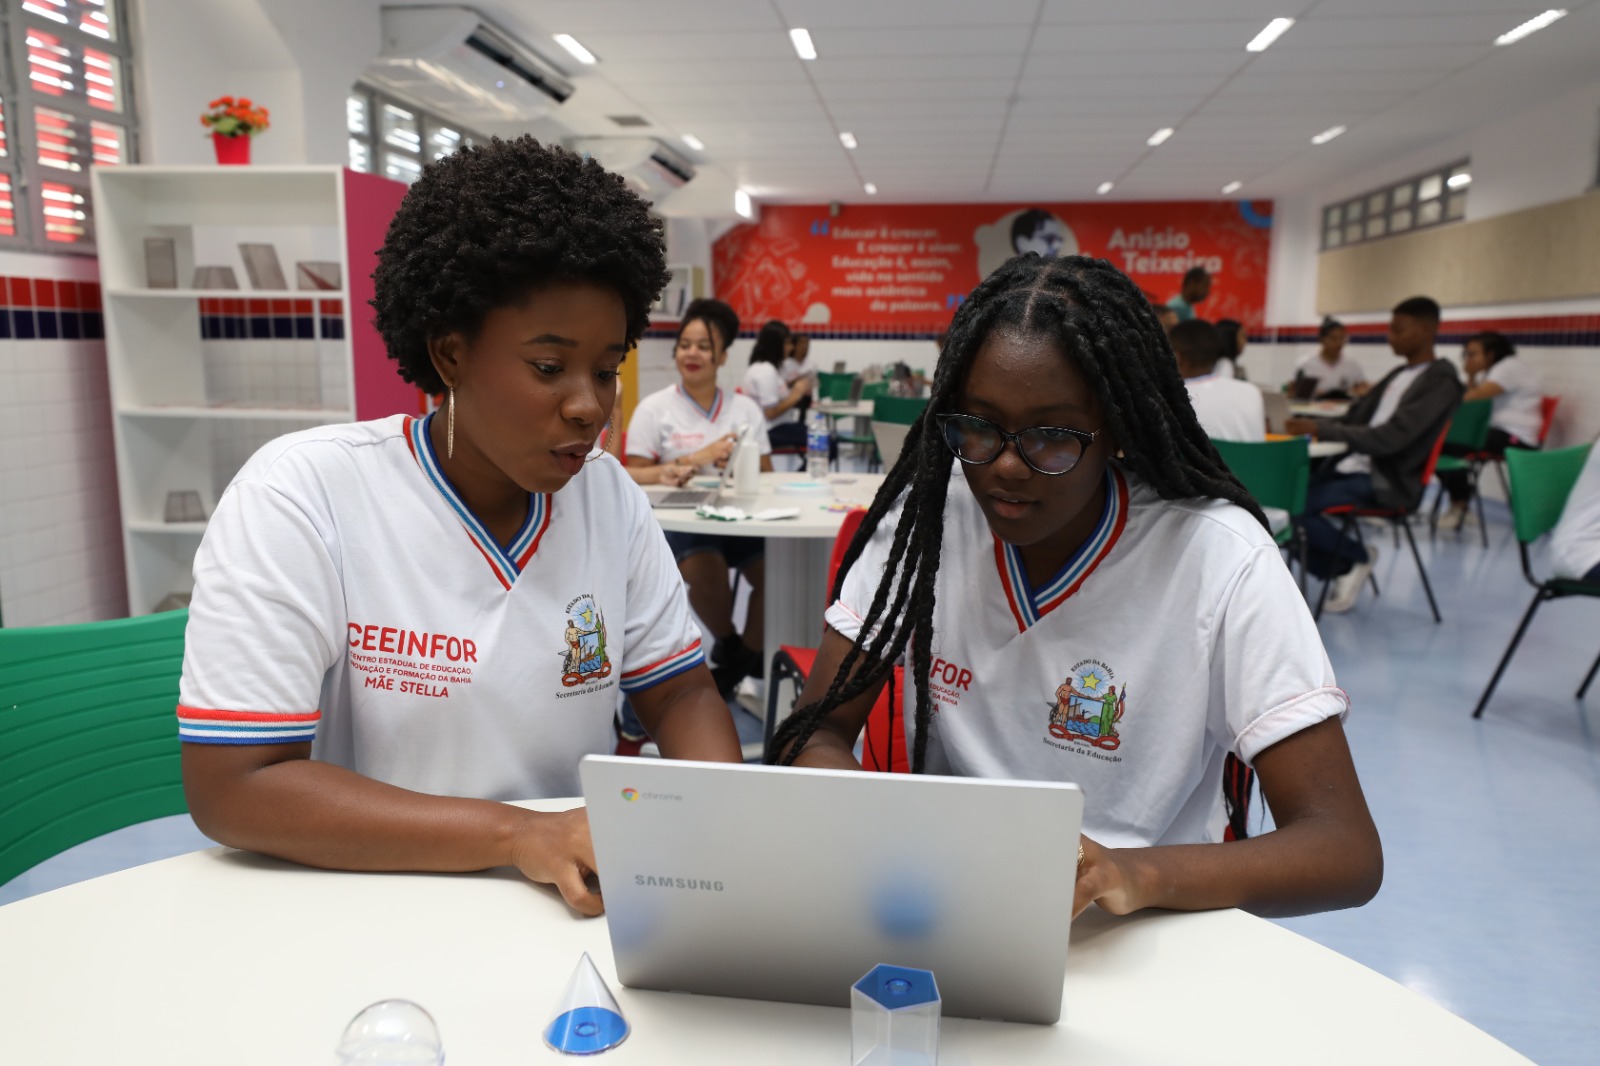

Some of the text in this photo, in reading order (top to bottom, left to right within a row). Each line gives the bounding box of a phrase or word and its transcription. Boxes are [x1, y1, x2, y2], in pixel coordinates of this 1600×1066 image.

[566, 596, 582, 614] ESTADO
[348, 622, 478, 663] CEEINFOR
[350, 660, 384, 674] NOVAÇÃO
[393, 668, 436, 680] FORMAÇÃO
[378, 656, 418, 668] ESTADUAL
[1071, 659, 1092, 672] ESTADO
[1100, 662, 1115, 680] BAHIA
[365, 675, 449, 698] MÃE STELLA
[932, 692, 940, 700] DA
[1043, 737, 1074, 752] Secretaria
[1087, 750, 1122, 762] Educação
[642, 792, 682, 802] chrome
[635, 874, 724, 892] SAMSUNG
